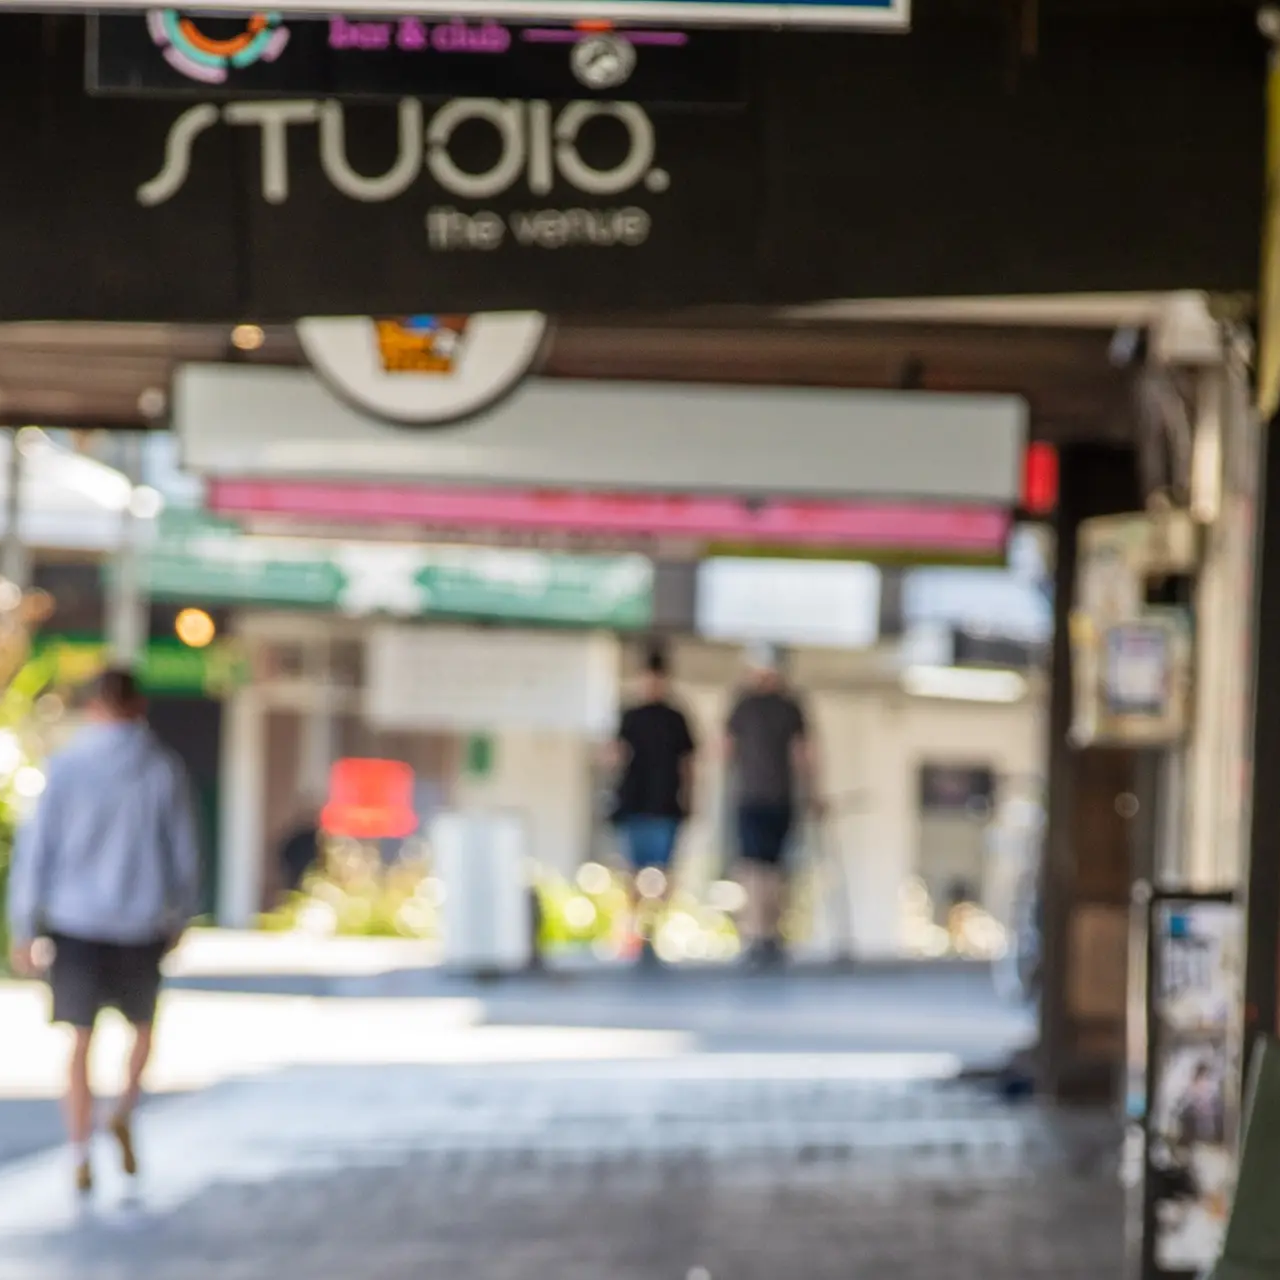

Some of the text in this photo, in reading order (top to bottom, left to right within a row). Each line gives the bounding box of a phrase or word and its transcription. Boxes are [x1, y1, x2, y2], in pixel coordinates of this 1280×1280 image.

[328, 15, 511, 53] bar & club
[425, 206, 651, 250] the venue
